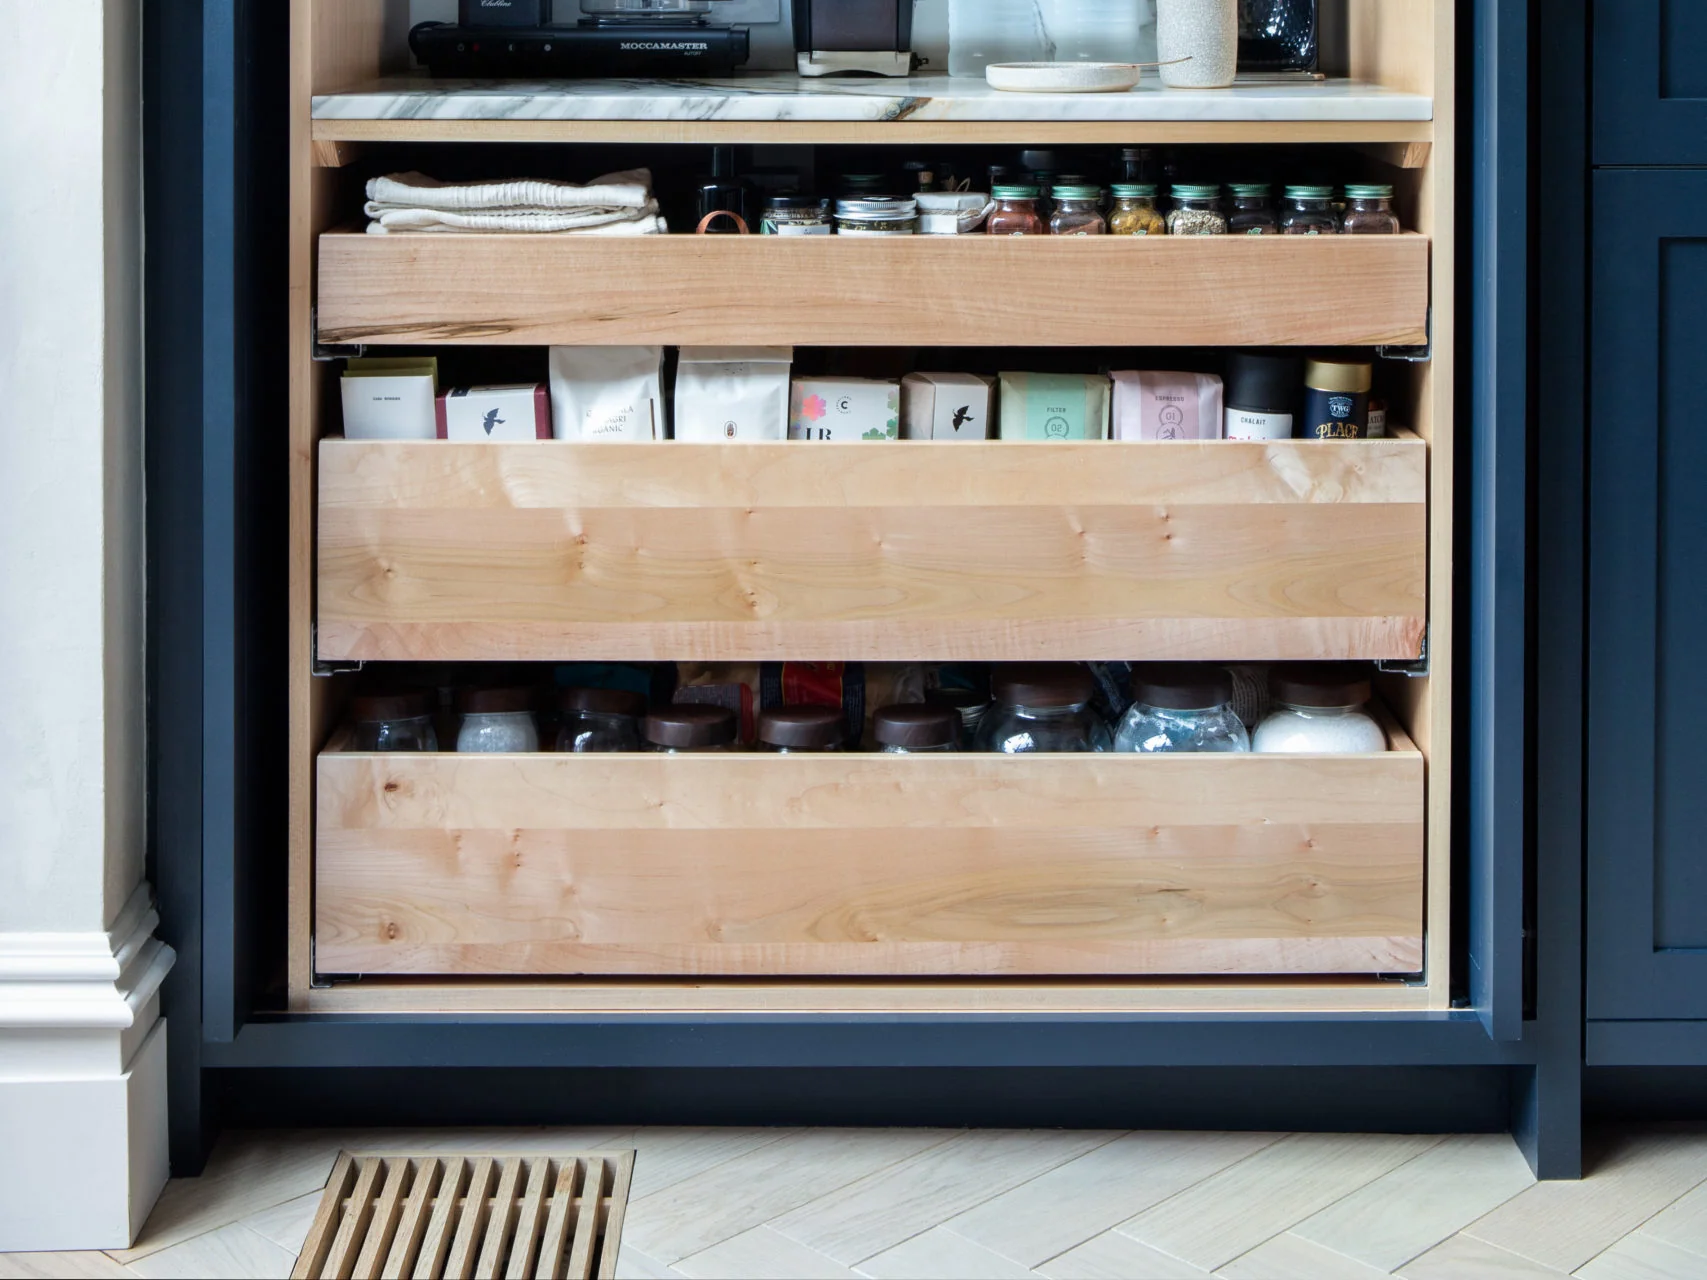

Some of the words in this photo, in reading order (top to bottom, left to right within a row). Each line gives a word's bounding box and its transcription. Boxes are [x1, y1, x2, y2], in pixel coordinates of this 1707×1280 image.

[620, 42, 708, 50] MOCCAMASTER
[840, 400, 849, 410] C
[1331, 404, 1350, 412] TWG
[1165, 412, 1176, 421] 01
[1240, 416, 1267, 425] CHALAIT
[1051, 423, 1063, 433] 02
